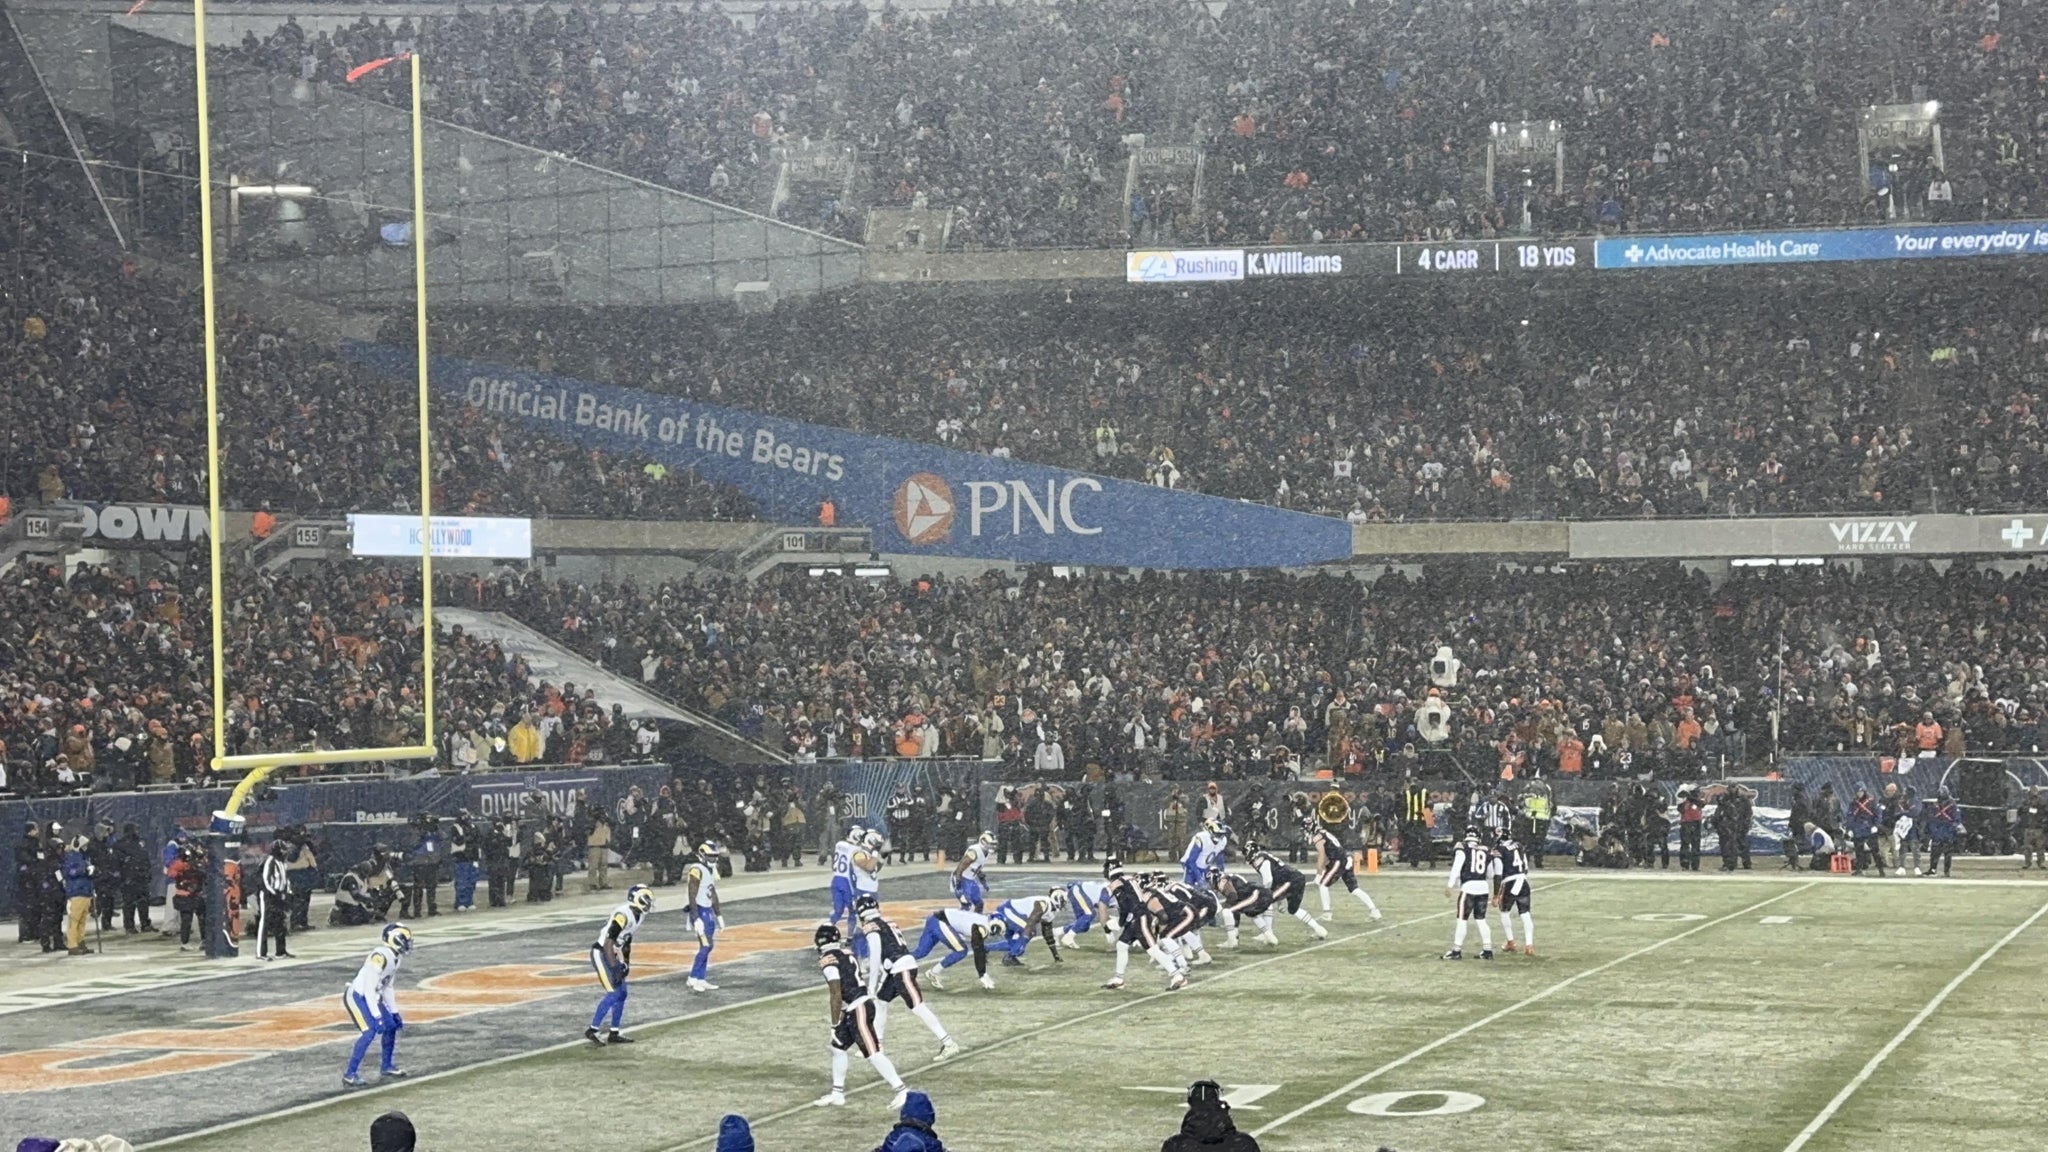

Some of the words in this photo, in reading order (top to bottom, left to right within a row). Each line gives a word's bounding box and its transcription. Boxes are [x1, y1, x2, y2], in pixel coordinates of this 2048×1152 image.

[1645, 243, 1721, 261] Advocate
[1722, 240, 1777, 259] Health
[1779, 240, 1819, 257] Care
[1894, 233, 1939, 252] Your
[1941, 229, 2031, 253] everyday
[1176, 257, 1239, 277] Rushing
[1247, 251, 1342, 275] K.Williams
[1418, 248, 1431, 270] 4
[1434, 247, 1479, 270] CARR
[1518, 245, 1538, 267] 18
[1543, 245, 1576, 267] YDS
[467, 375, 567, 422] Official
[576, 393, 649, 442] Bank
[658, 414, 690, 443] of
[696, 418, 744, 459] the
[752, 428, 845, 482] Bears
[963, 477, 1102, 536] PNC
[27, 519, 49, 535] 154
[297, 529, 319, 544] 155
[1828, 521, 1918, 543] VIZZY
[785, 535, 804, 549] 101
[1838, 543, 1865, 552] HARD
[1620, 752, 1632, 764] 23
[481, 788, 577, 818] DIVISONA
[832, 851, 848, 874] 26
[1470, 848, 1487, 875] 18
[1834, 856, 1848, 871] 10
